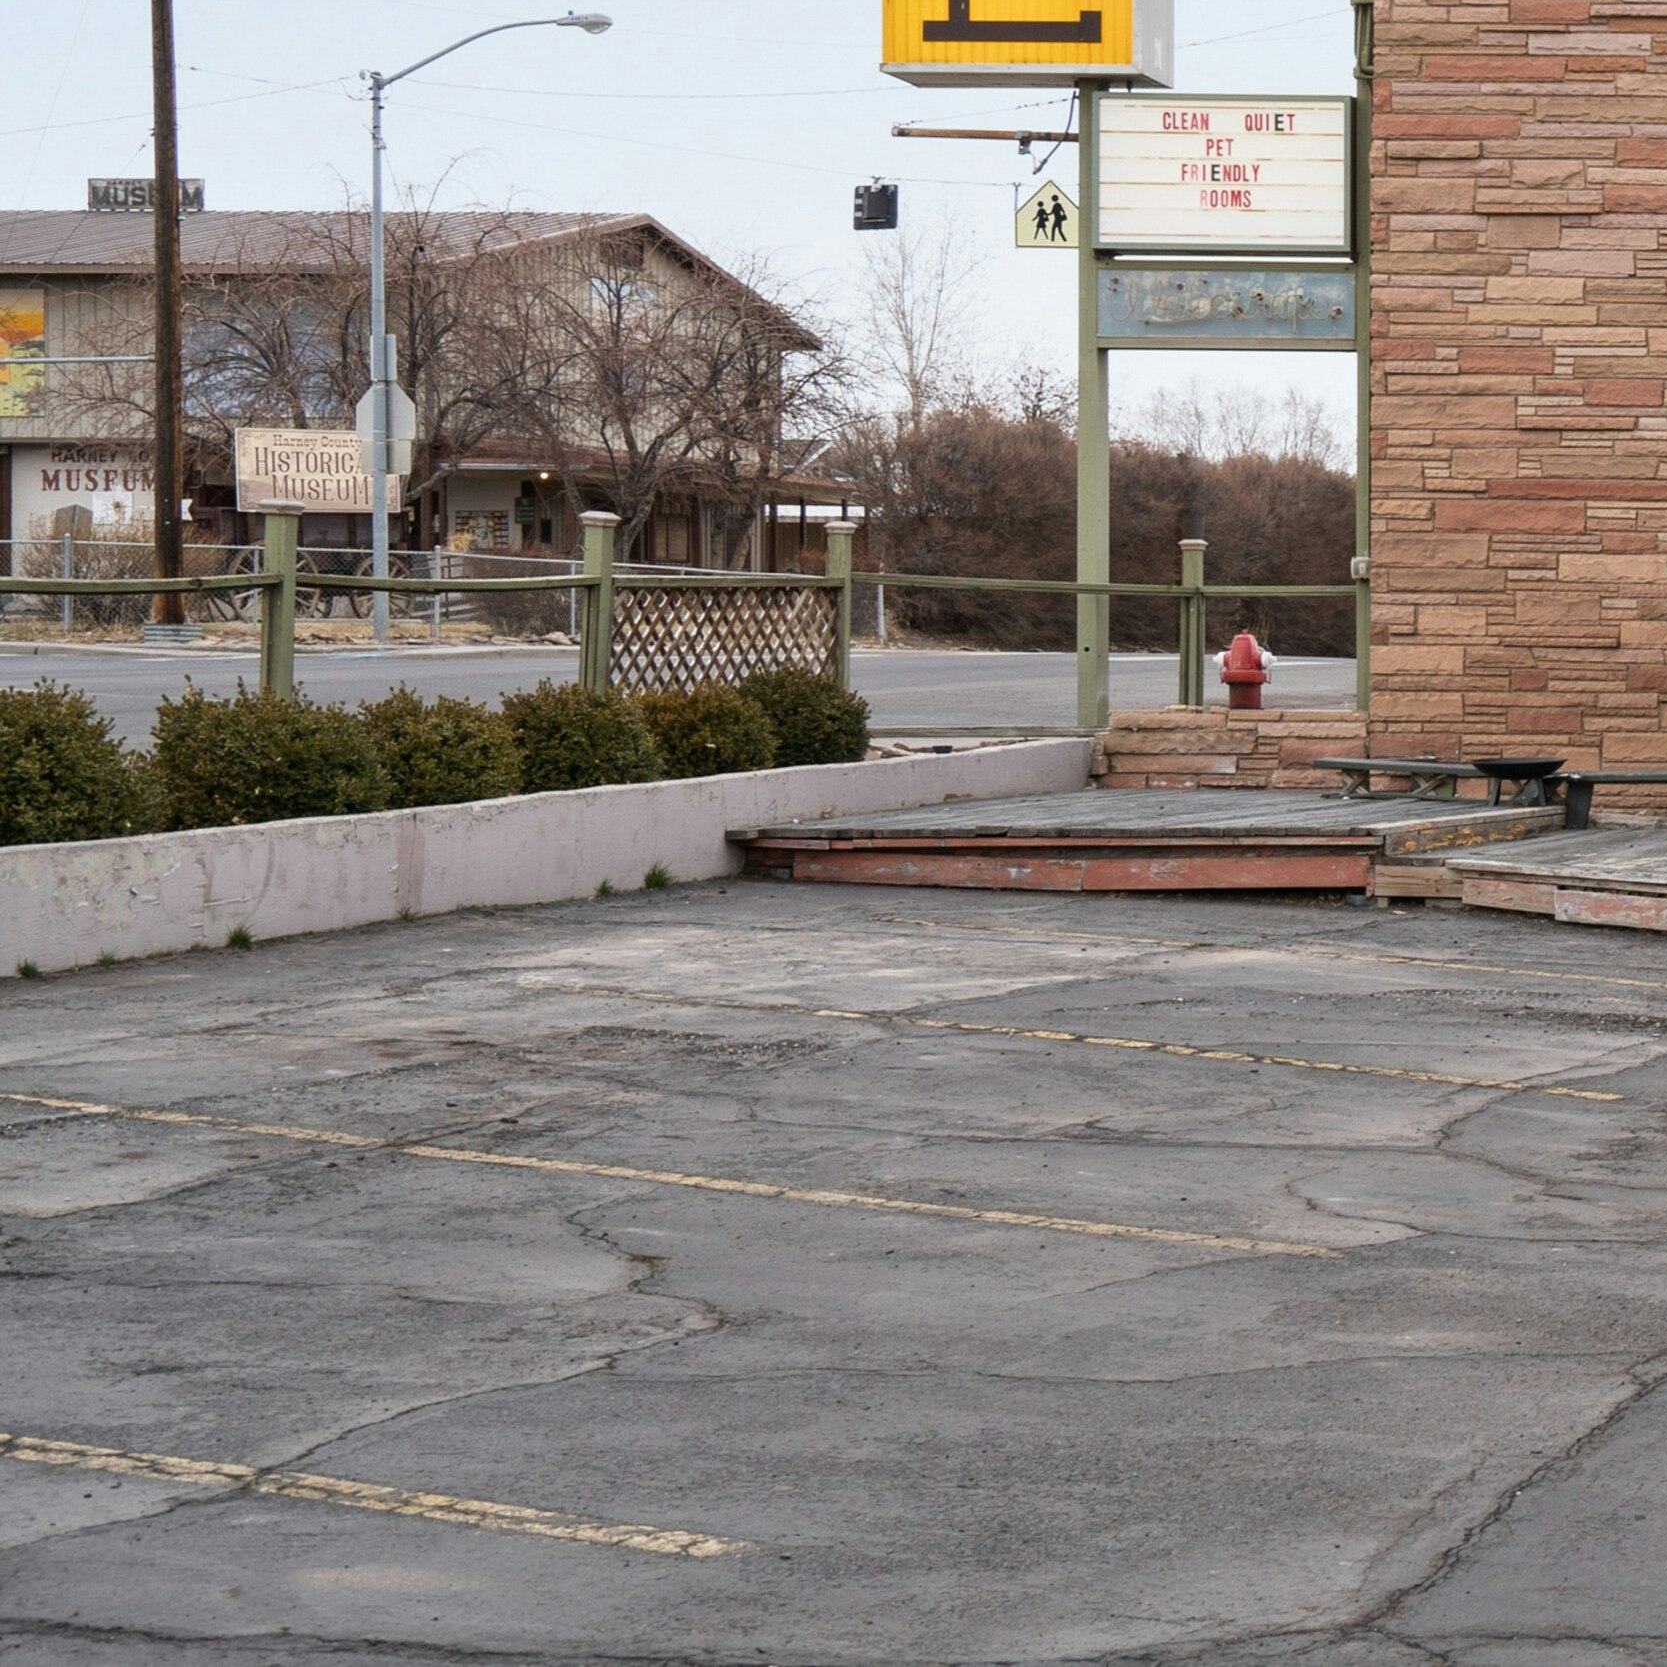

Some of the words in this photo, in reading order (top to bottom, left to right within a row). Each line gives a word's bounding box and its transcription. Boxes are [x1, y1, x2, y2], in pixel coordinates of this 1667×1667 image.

[1162, 112, 1209, 130] CLEAN
[1245, 114, 1295, 131] QUIET
[1206, 138, 1234, 156] PET
[1181, 163, 1260, 182] FRIENDLY
[91, 185, 203, 206] MUSM
[1200, 189, 1251, 207] ROOMS
[273, 435, 318, 450] Harney
[321, 436, 362, 452] County
[255, 447, 374, 476] HISTORIC
[272, 474, 369, 505] MUSEUM
